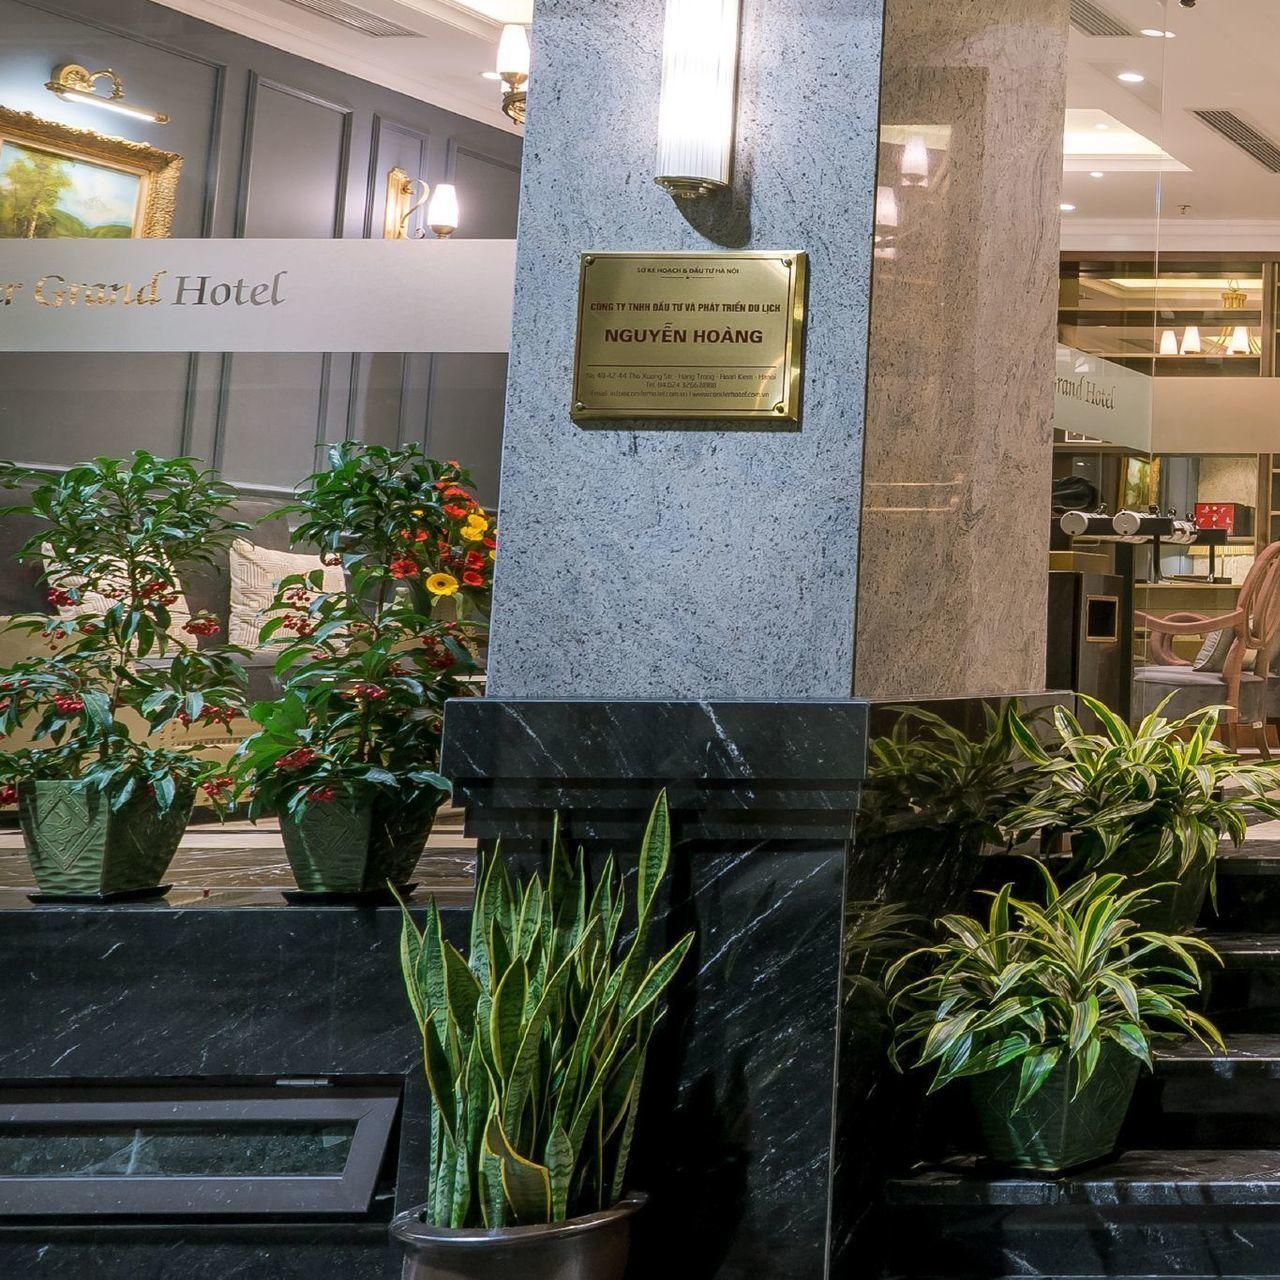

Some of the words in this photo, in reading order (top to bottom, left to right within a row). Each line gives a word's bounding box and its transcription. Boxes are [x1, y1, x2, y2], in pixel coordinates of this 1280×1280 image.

[34, 270, 168, 308] Grand
[171, 270, 289, 307] Hotel
[616, 303, 626, 312] TY
[628, 303, 651, 312] TNHH
[748, 303, 760, 313] DU
[762, 303, 781, 315] LỊCH
[604, 322, 687, 344] NGUYỄN
[693, 326, 763, 344] HOÀNG
[1055, 375, 1085, 401] rand
[1085, 381, 1117, 410] Hotel
